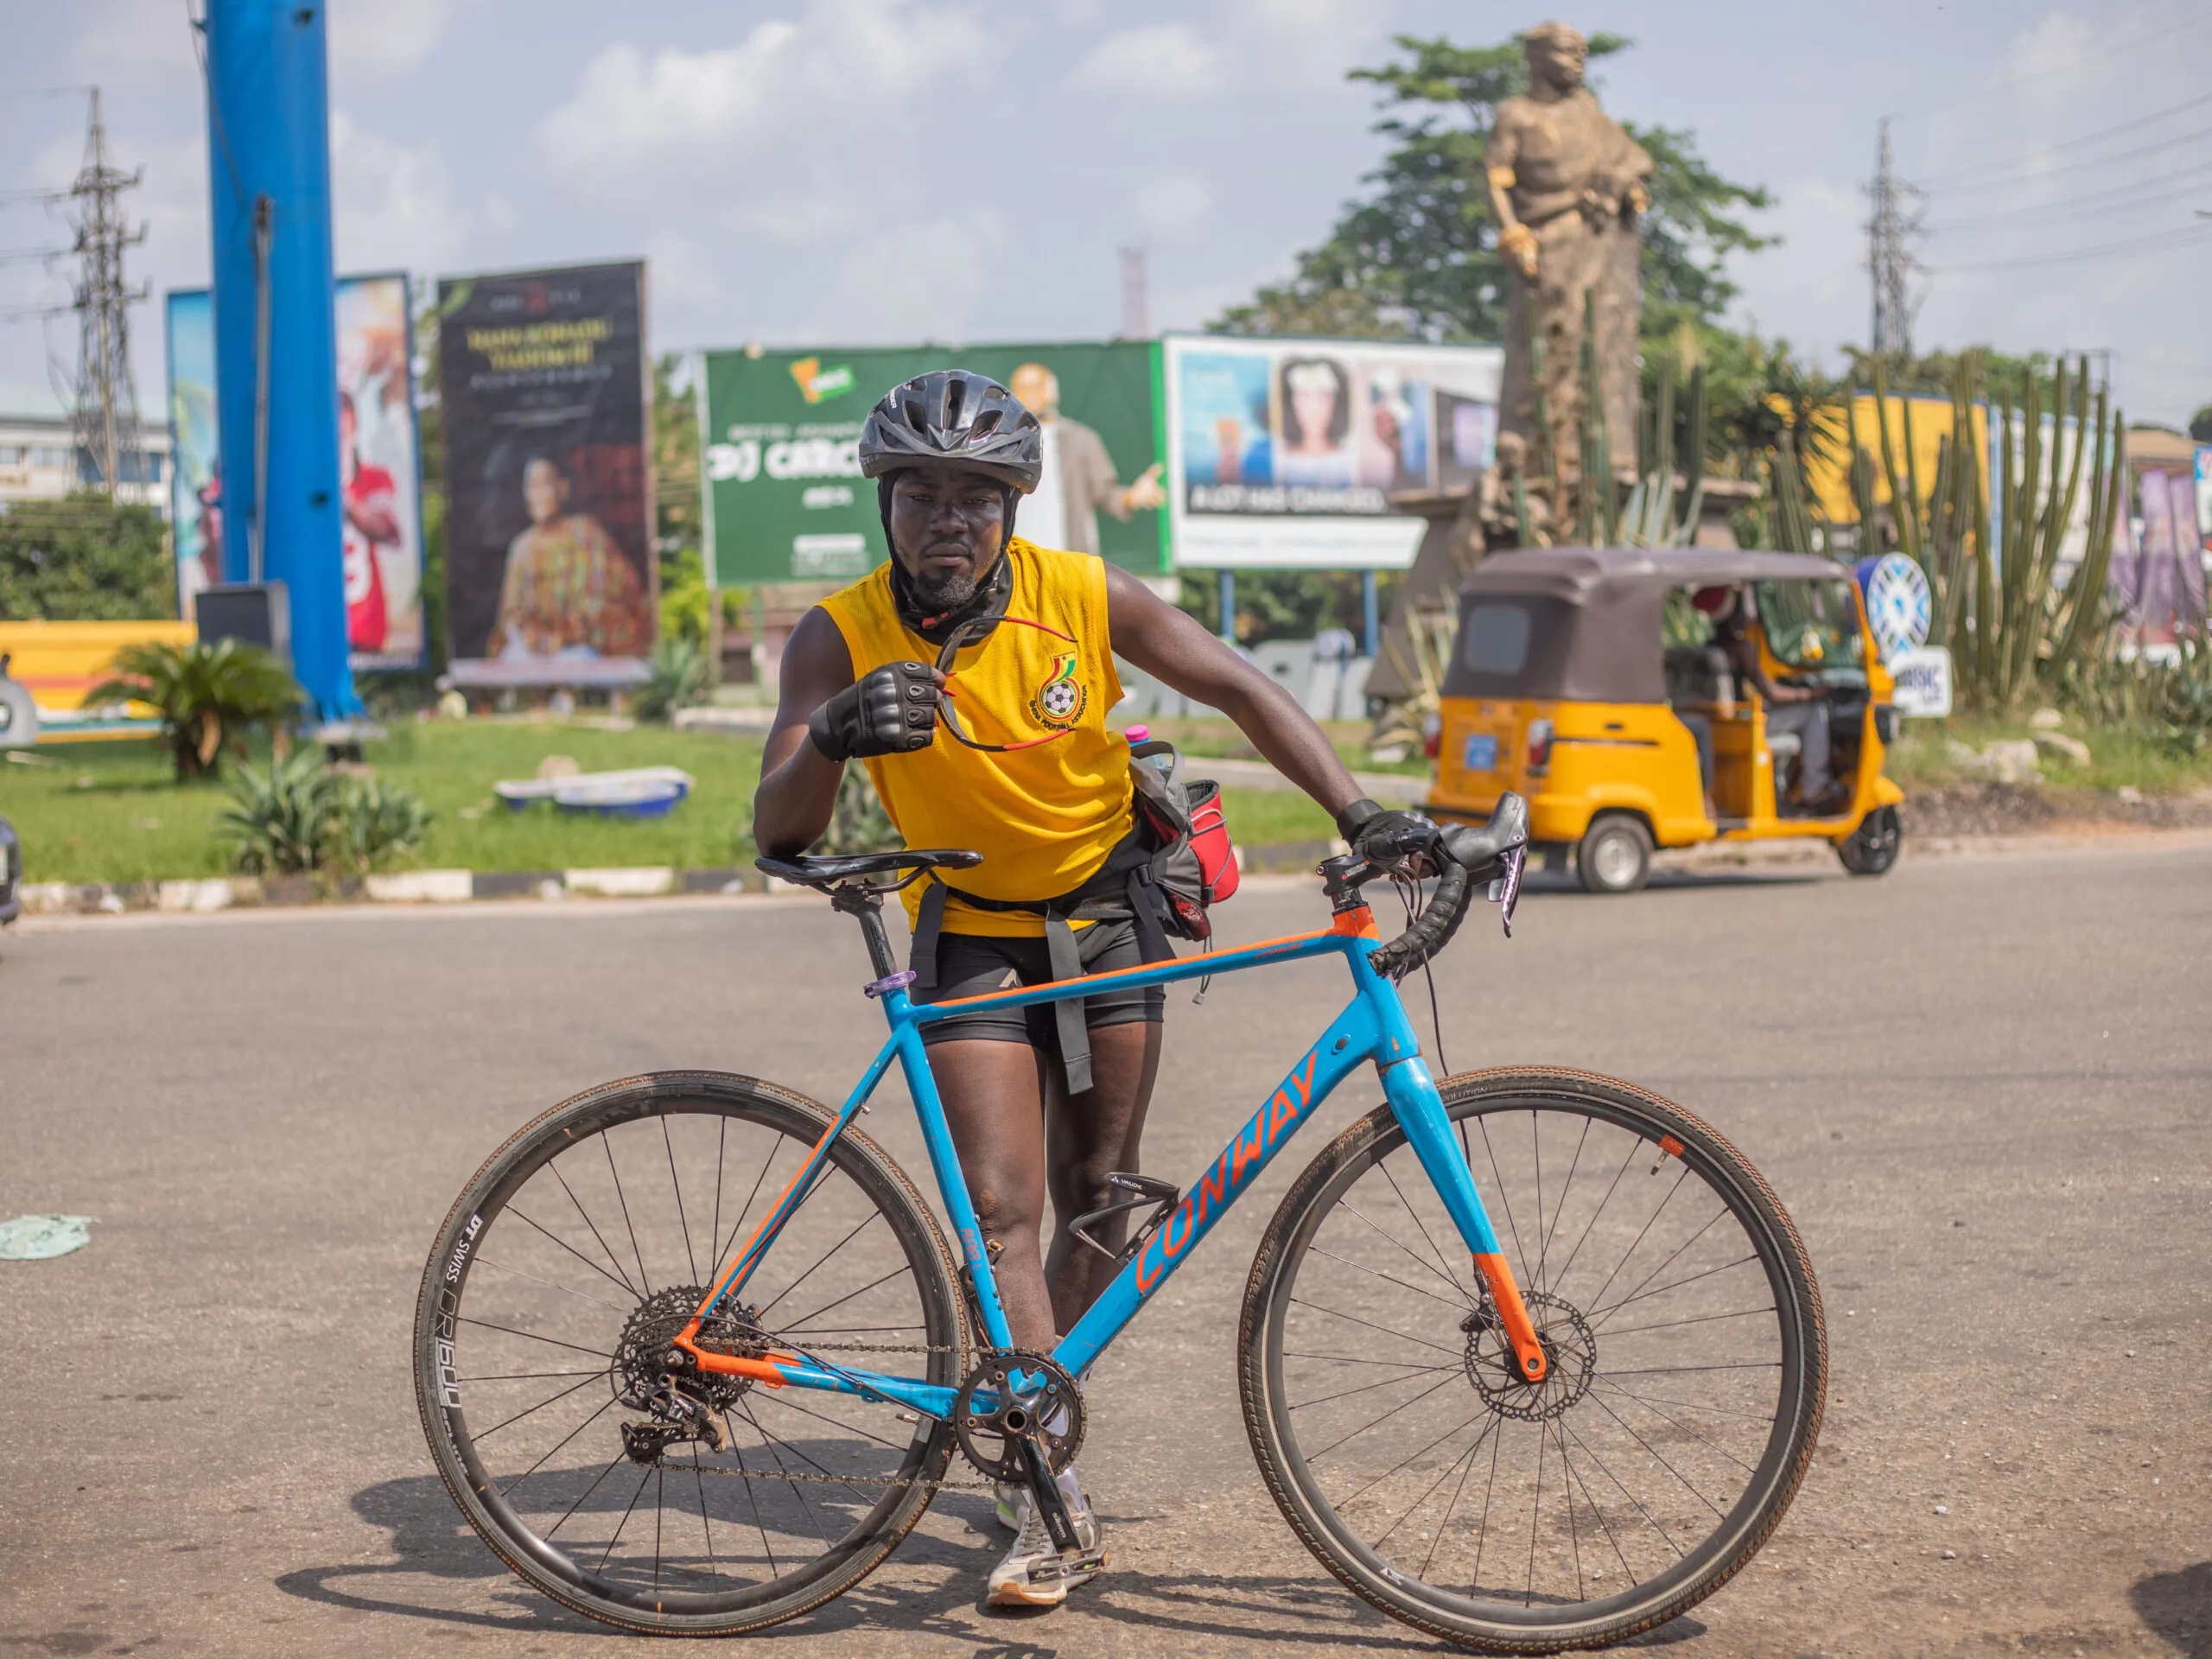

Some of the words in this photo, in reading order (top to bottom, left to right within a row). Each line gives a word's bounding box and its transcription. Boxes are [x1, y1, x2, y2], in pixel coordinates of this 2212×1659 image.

[1030, 700, 1041, 721] GHANA
[1041, 719, 1071, 729] FOOTBALL
[1071, 684, 1087, 725] ASSOCIATION
[1255, 941, 1306, 960] CONWAY
[1120, 1177, 1143, 1191] VAUDE
[1135, 1048, 1319, 1293] CONWAY
[465, 1213, 484, 1241] DT
[446, 1239, 470, 1283] SWISS
